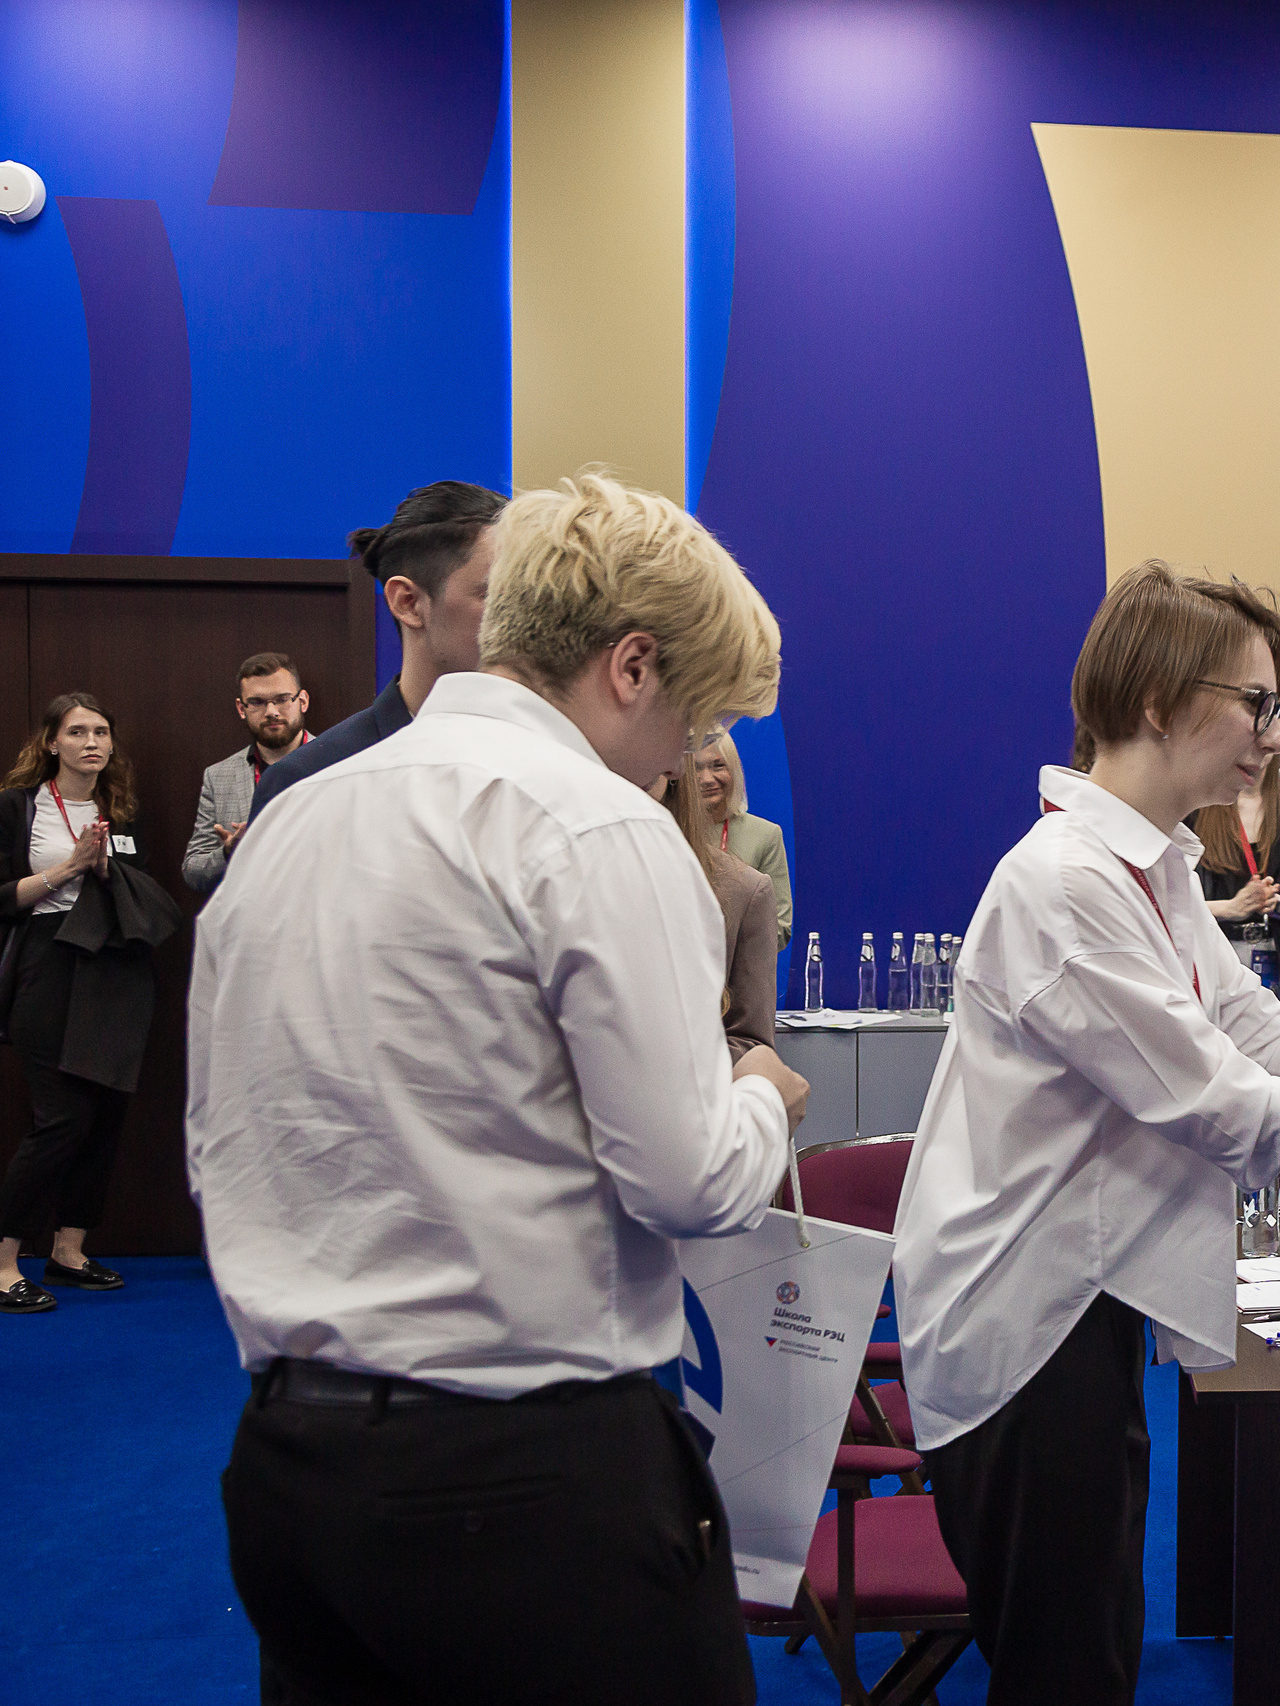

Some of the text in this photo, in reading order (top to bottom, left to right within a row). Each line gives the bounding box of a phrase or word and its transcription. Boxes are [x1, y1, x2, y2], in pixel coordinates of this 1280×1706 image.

[774, 1307, 812, 1323] Школа
[770, 1319, 846, 1343] экспорта РЭЦ
